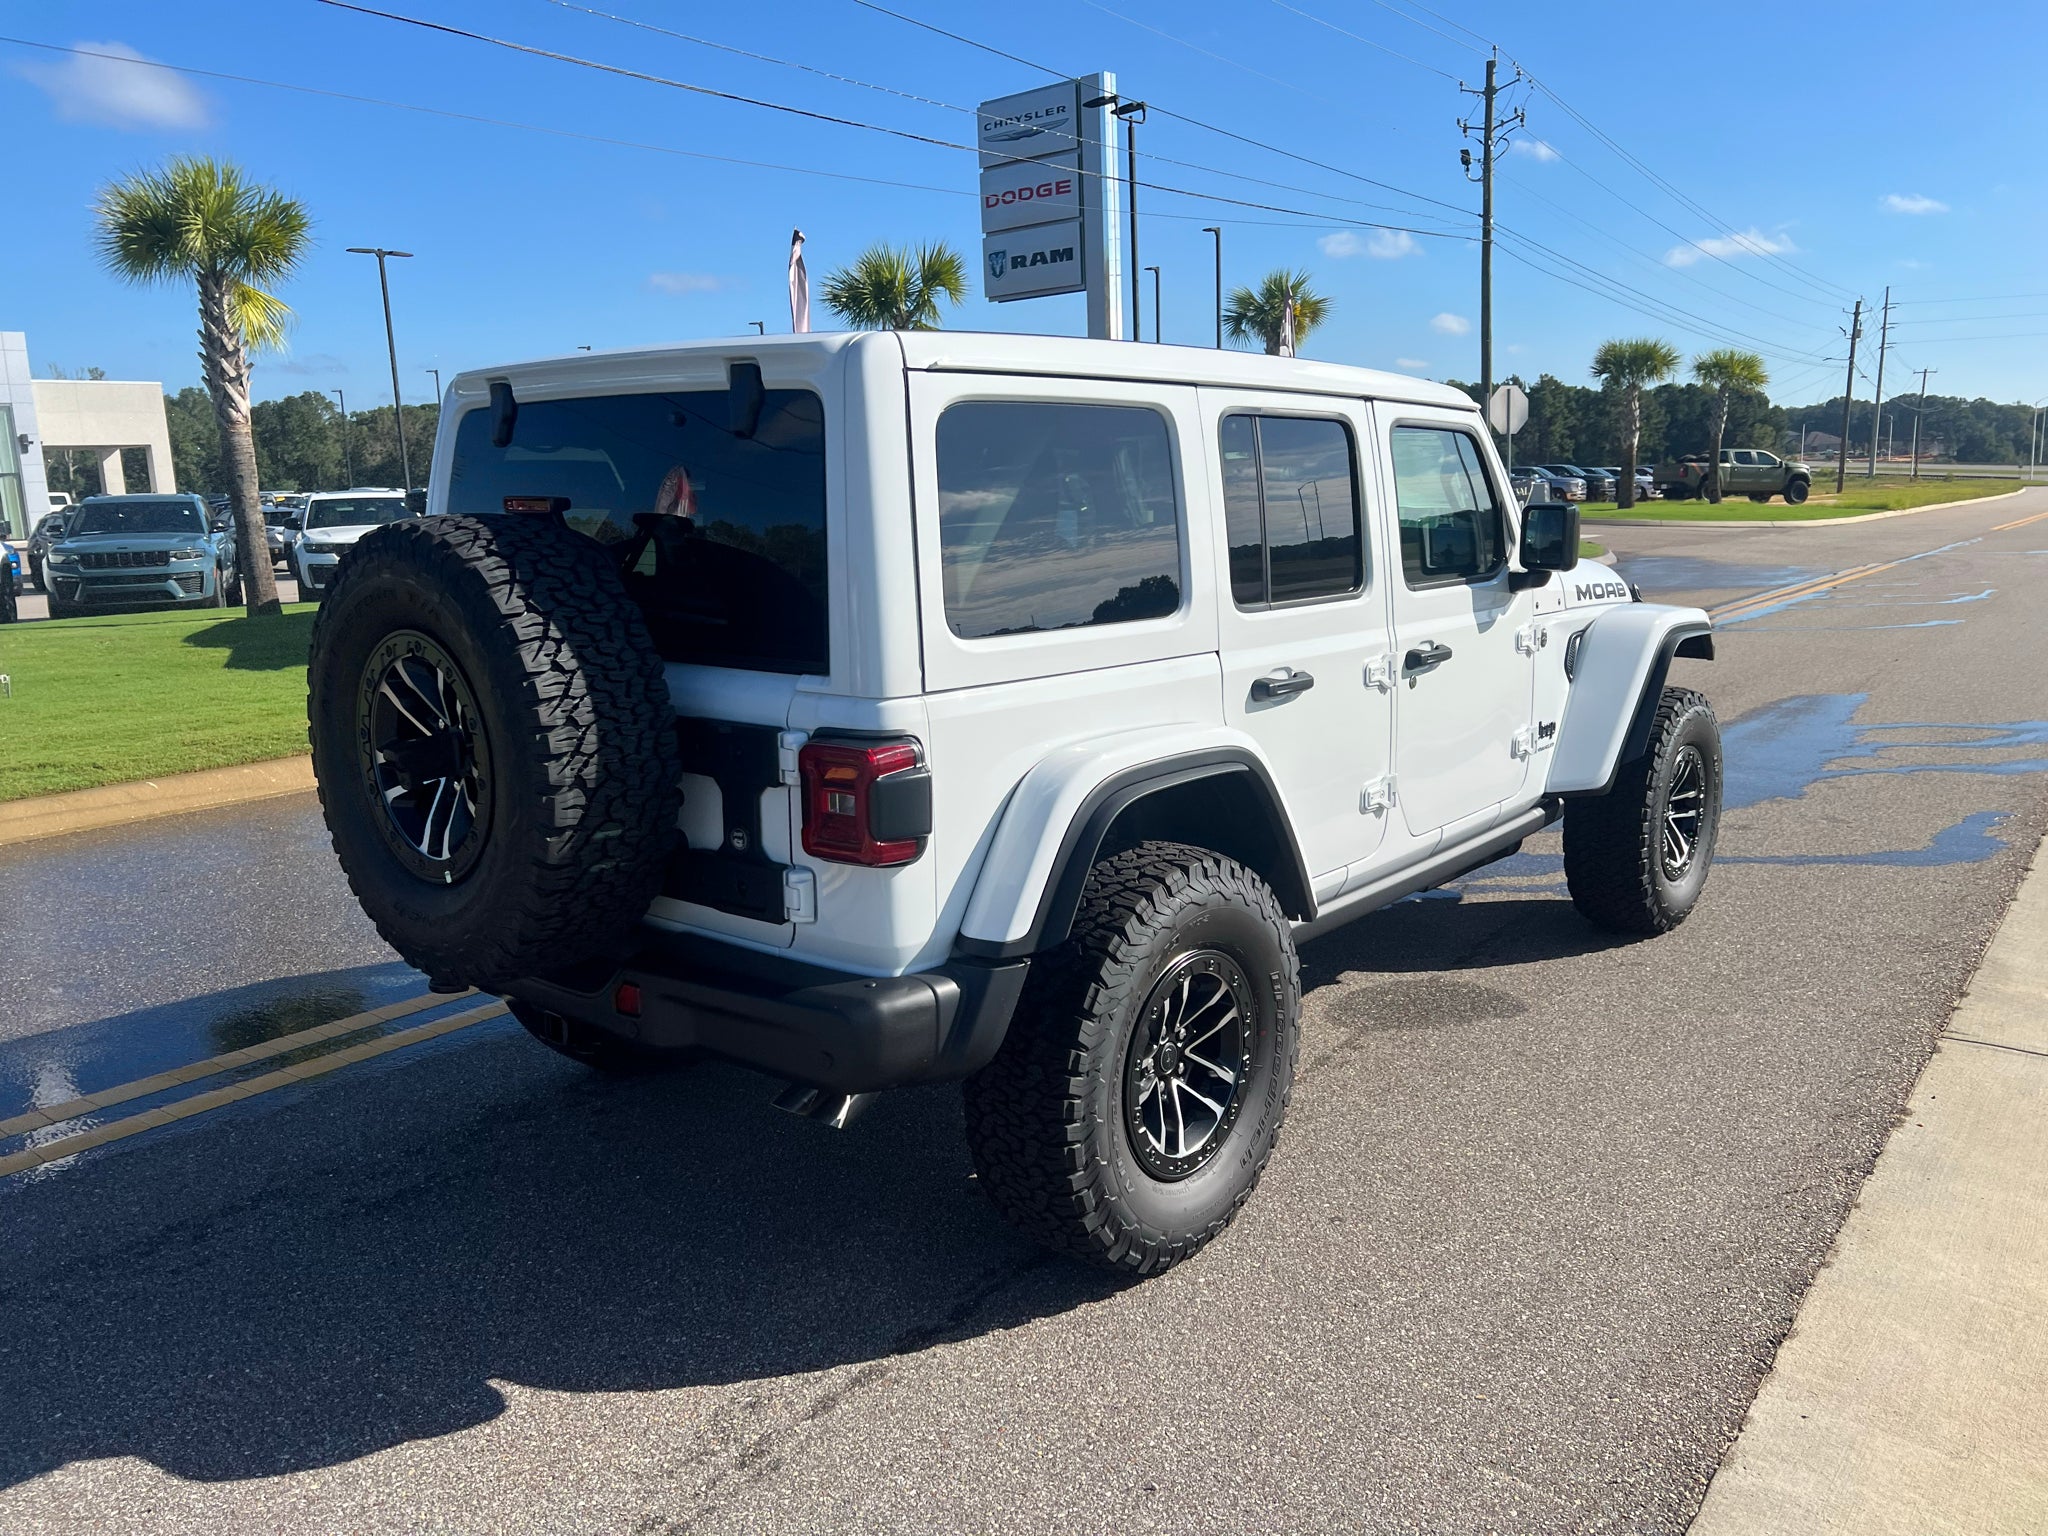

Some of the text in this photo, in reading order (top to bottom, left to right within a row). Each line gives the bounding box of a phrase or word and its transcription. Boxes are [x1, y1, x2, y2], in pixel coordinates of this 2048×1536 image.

[983, 105, 1067, 131] CHRYSLER
[985, 179, 1072, 209] DODGE
[1010, 246, 1073, 269] RAM
[1575, 582, 1627, 601] MOAB
